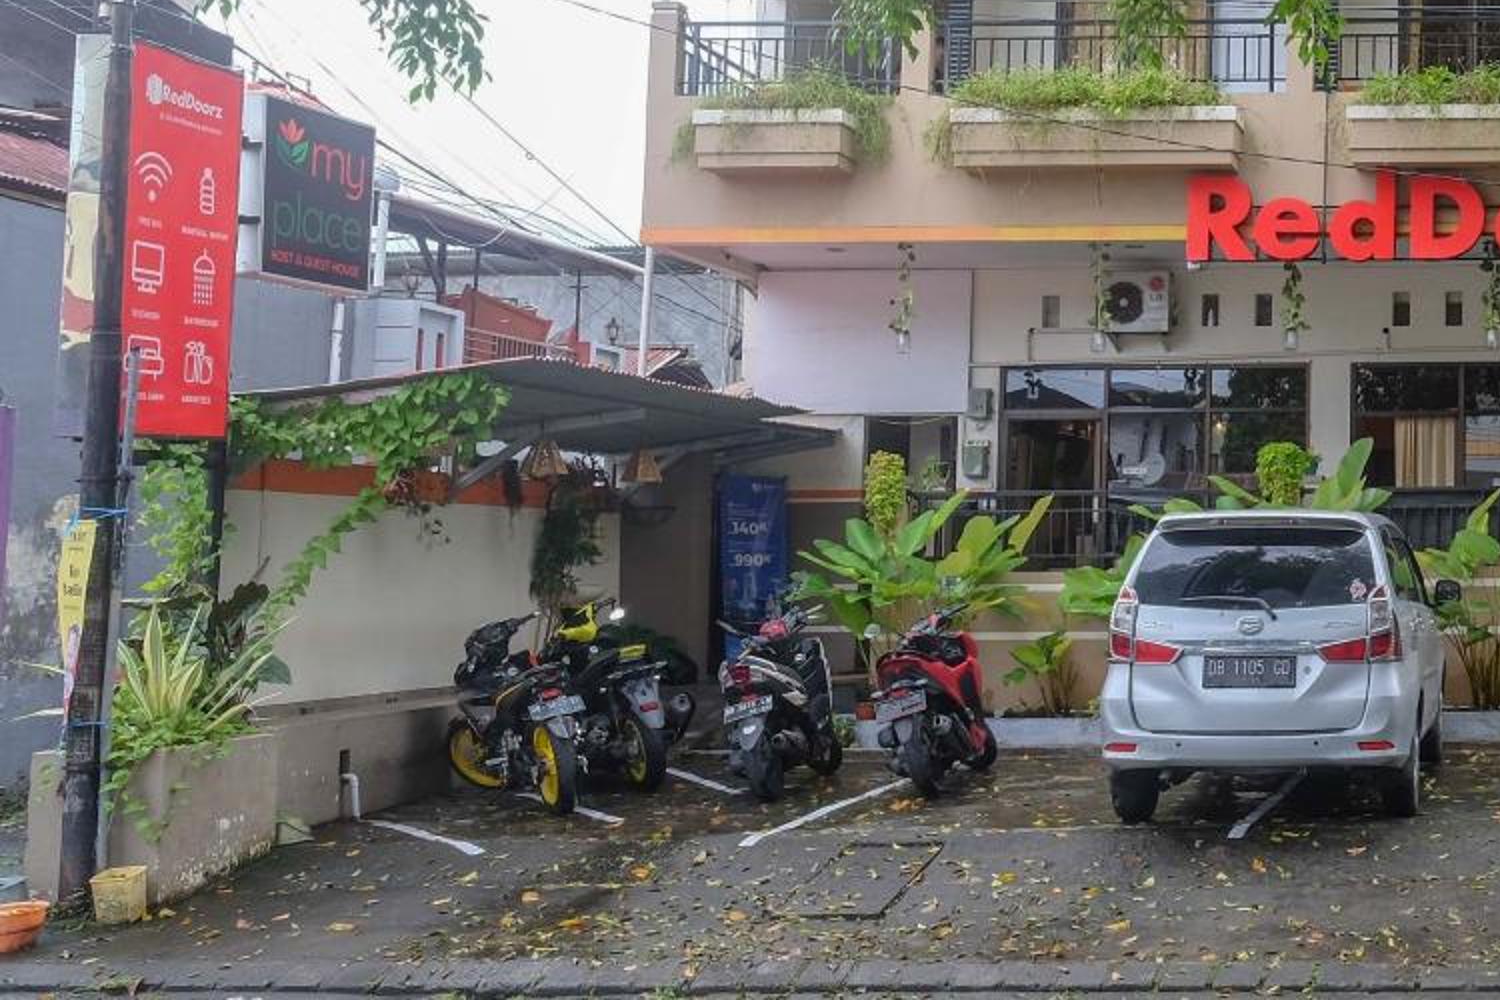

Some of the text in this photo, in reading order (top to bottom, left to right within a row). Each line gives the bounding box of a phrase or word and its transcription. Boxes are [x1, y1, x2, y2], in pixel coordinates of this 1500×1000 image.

[162, 84, 224, 119] RedDoorz
[311, 141, 365, 201] my
[273, 189, 362, 251] place
[1208, 659, 1225, 676] DB
[1234, 659, 1265, 676] 1105
